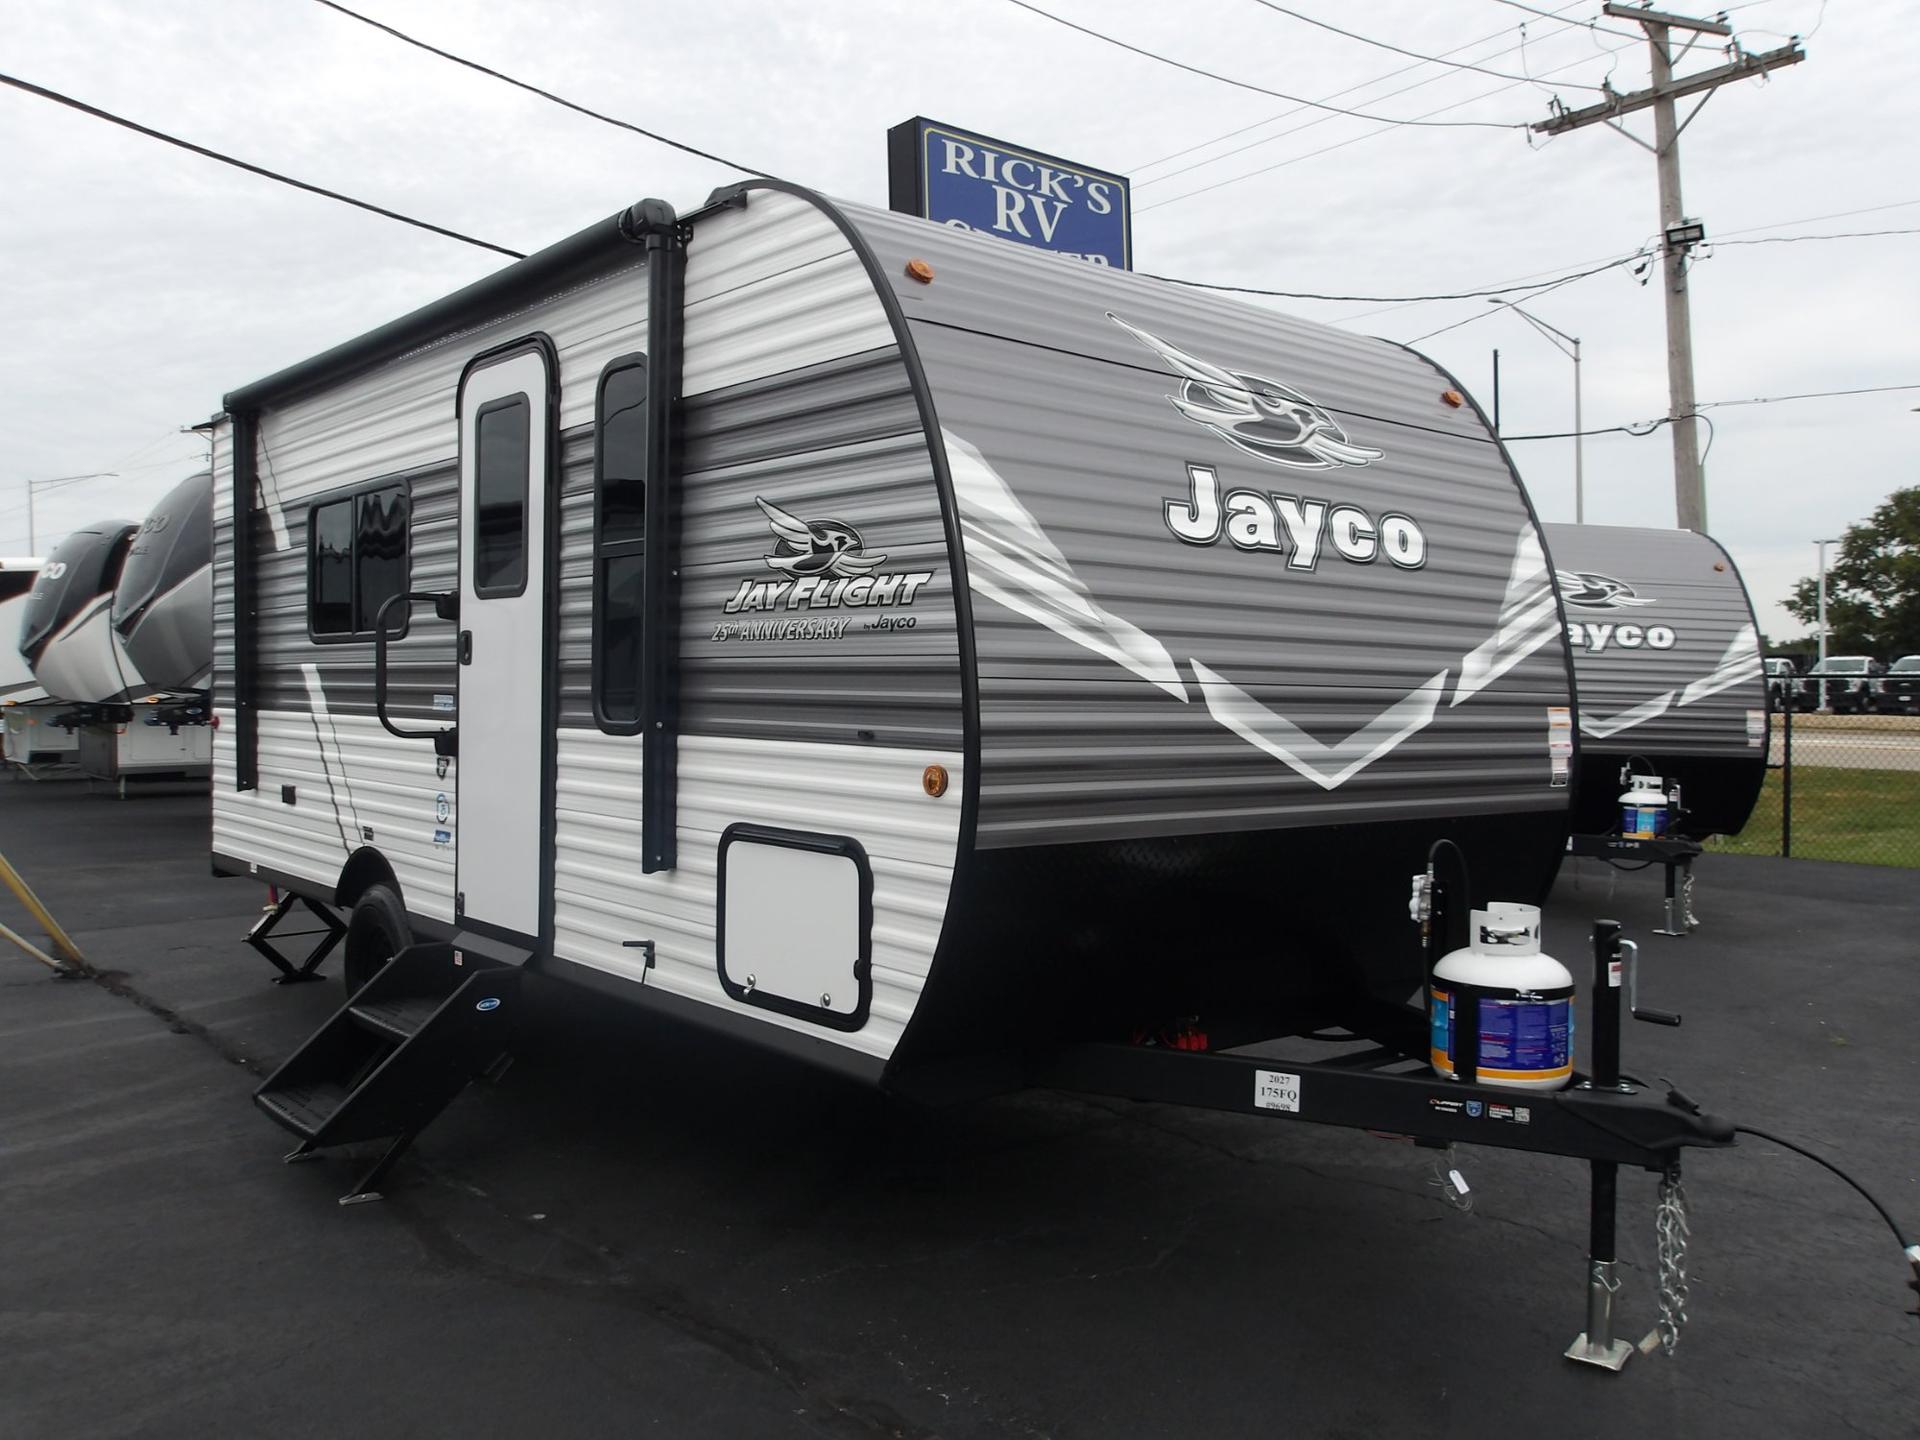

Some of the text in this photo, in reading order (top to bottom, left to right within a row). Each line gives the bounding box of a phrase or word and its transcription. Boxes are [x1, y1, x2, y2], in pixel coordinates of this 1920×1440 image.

[941, 138, 1112, 215] RICK'S
[991, 184, 1068, 243] RV
[1162, 462, 1427, 573] Jayco
[723, 571, 935, 614] JAY FLIGHT
[712, 616, 851, 641] 25th ANNIVERSARY
[871, 614, 917, 632] Jayco
[1567, 621, 1676, 653] ayco
[1269, 1074, 1291, 1085] 2027
